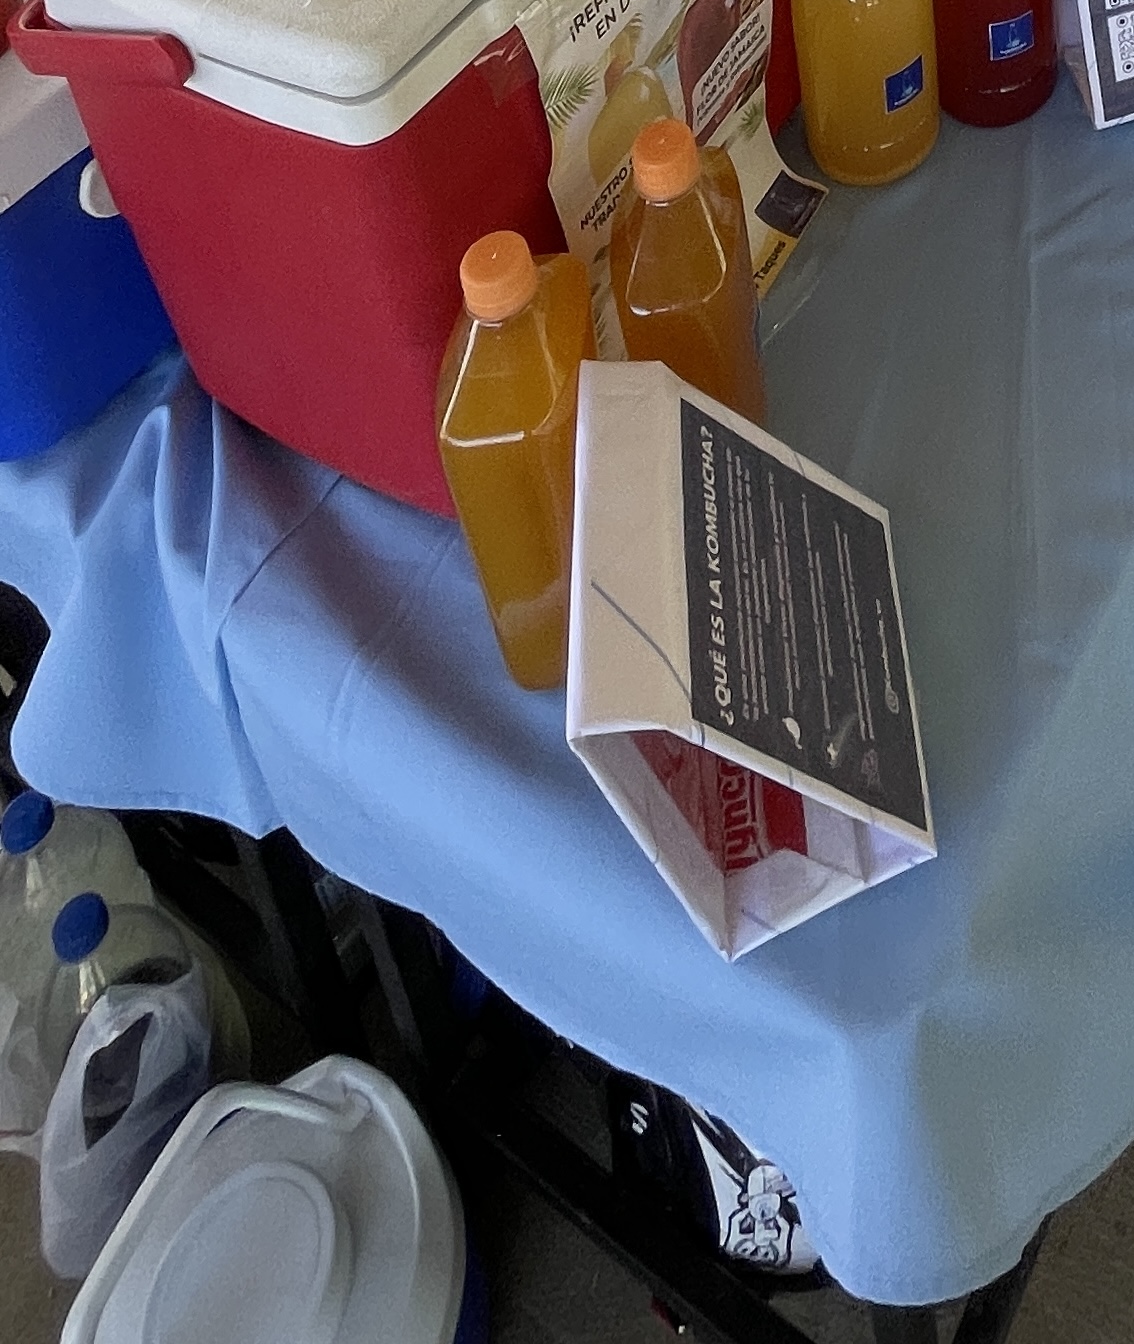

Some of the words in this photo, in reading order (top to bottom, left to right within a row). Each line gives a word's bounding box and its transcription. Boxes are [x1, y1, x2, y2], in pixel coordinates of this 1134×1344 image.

[595, 7, 617, 40] EN
[580, 166, 628, 230] NUESTRO
[700, 425, 720, 574] KOMBUCHA?
[708, 579, 723, 610] LA
[710, 612, 726, 647] ES
[708, 648, 735, 727] ¿QUÉ
